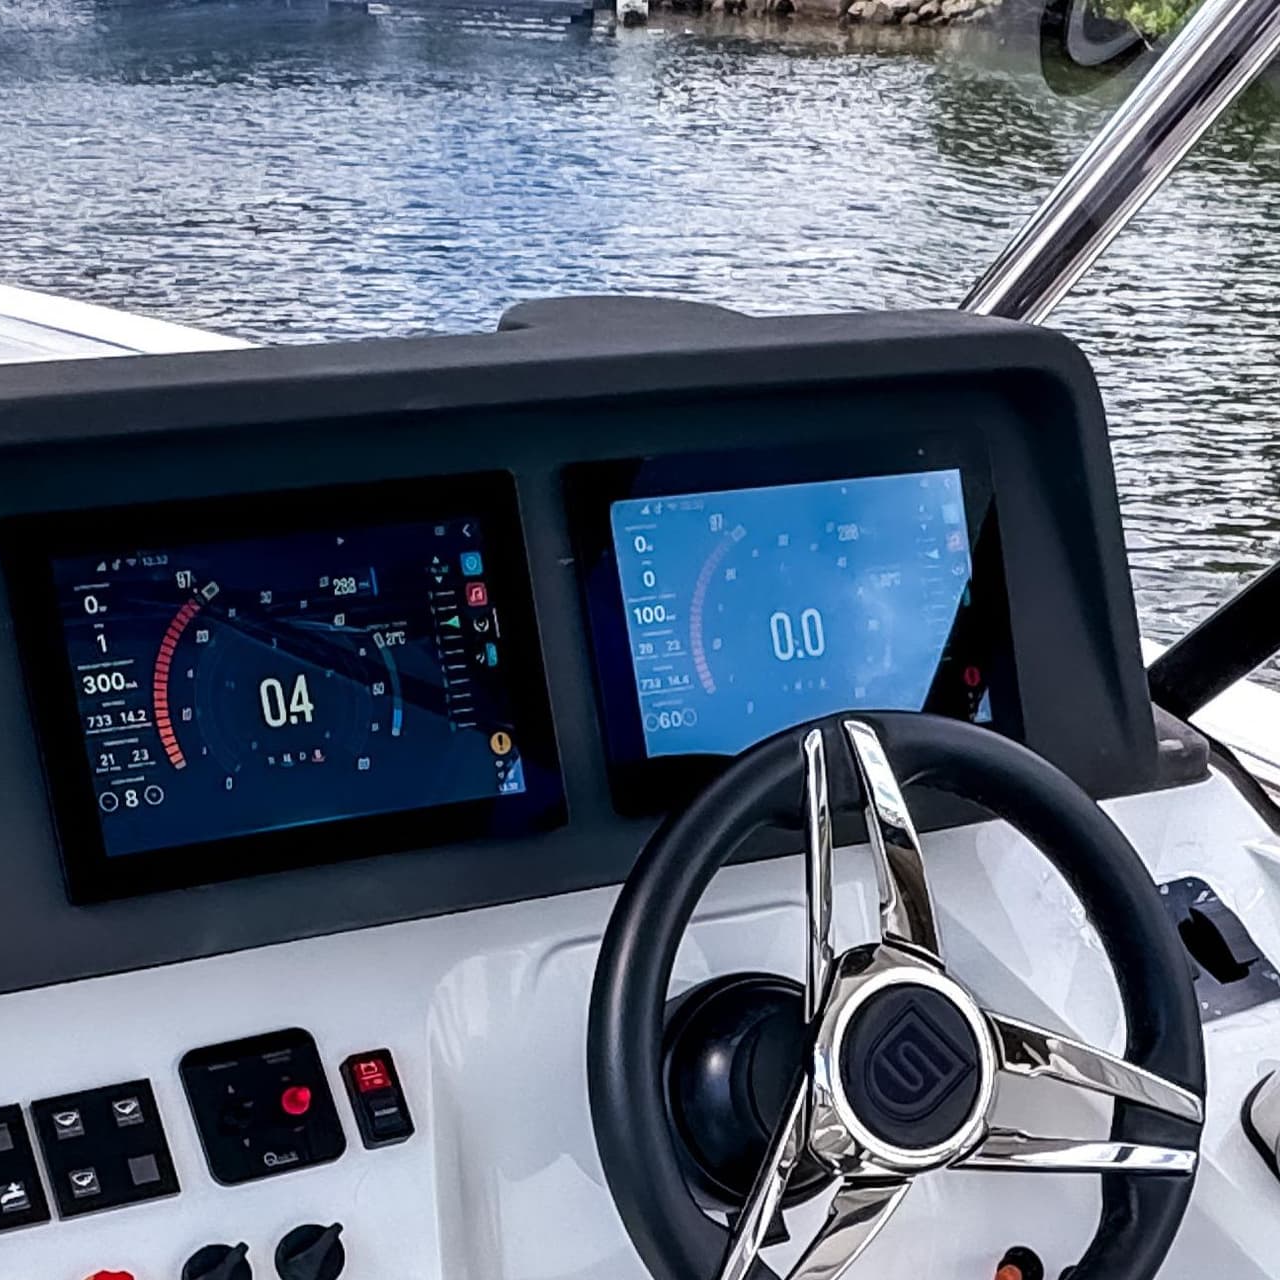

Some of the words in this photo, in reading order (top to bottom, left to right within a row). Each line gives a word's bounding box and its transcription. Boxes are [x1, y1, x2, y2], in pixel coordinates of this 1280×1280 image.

[643, 570, 656, 588] 0
[96, 634, 107, 653] 1
[770, 608, 825, 661] 0.0
[83, 672, 125, 694] 300
[259, 674, 315, 728] 0.4
[87, 714, 113, 728] 733
[659, 710, 682, 729] 60
[132, 748, 150, 762] 23
[125, 789, 139, 807] 8
